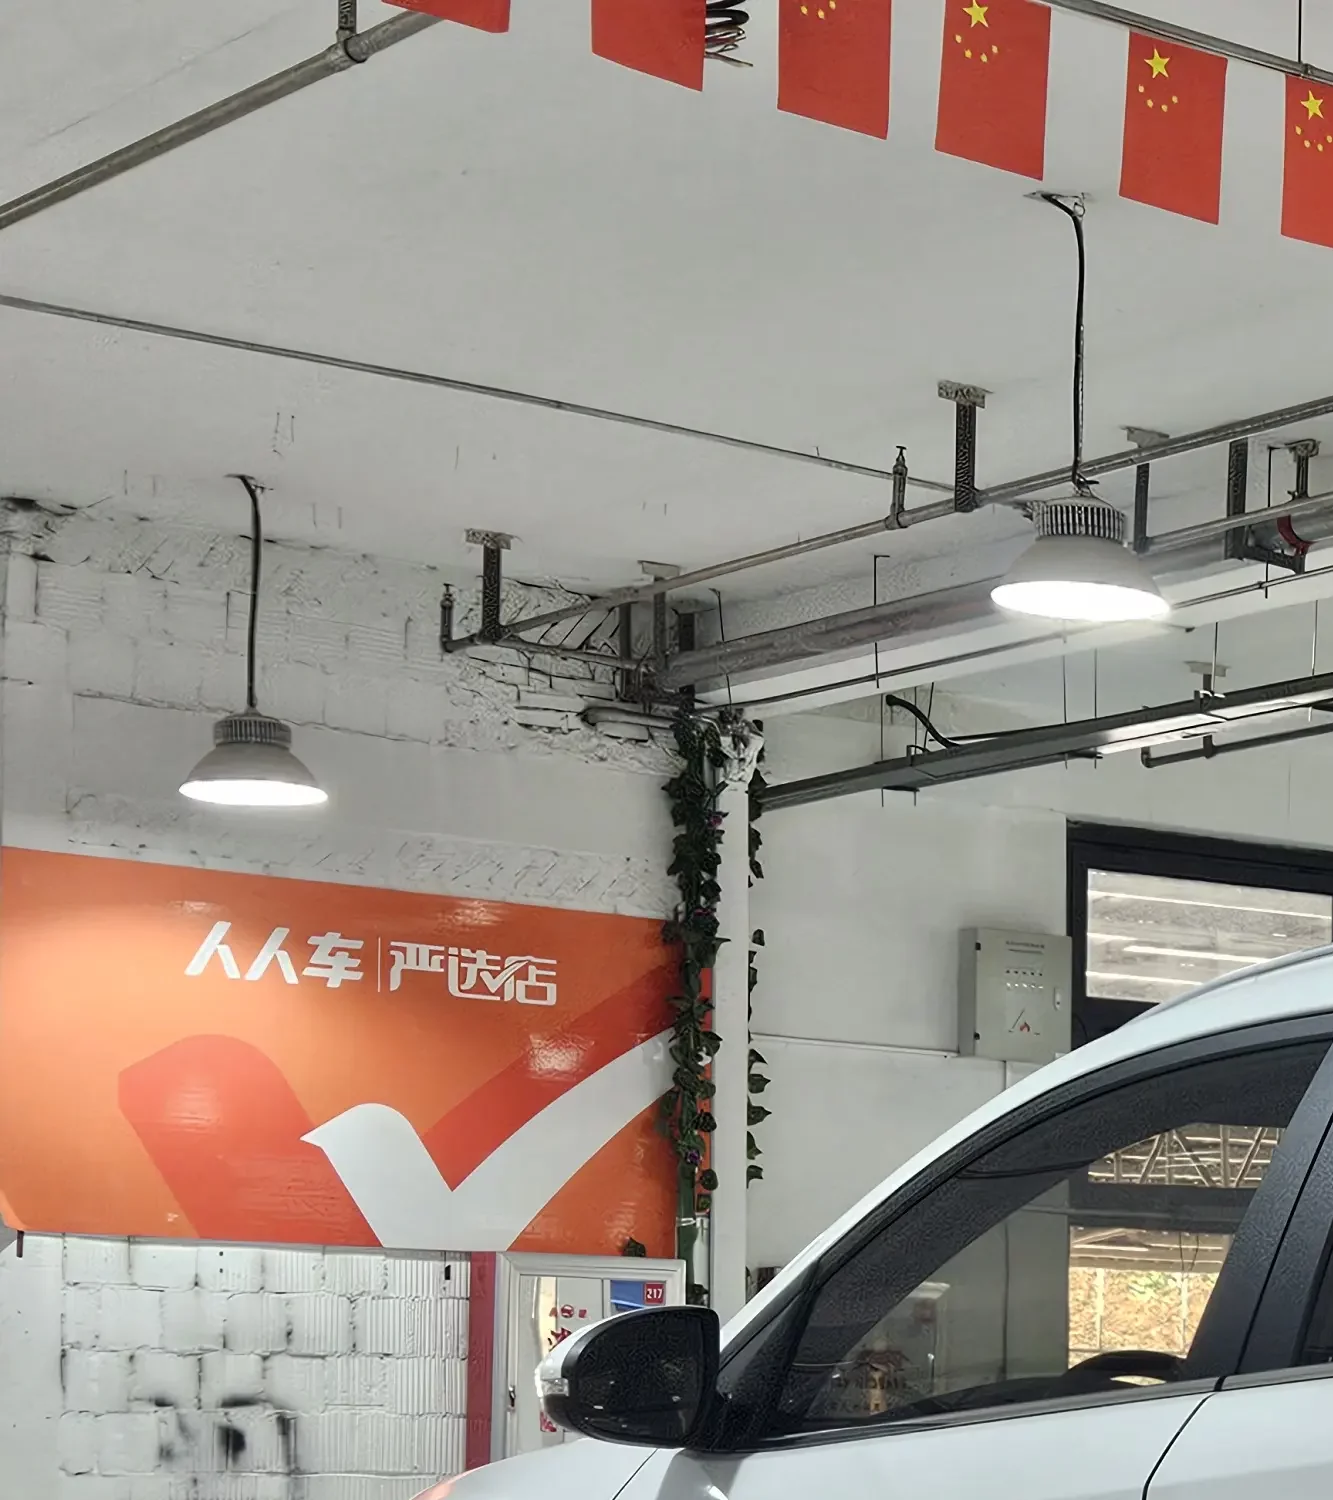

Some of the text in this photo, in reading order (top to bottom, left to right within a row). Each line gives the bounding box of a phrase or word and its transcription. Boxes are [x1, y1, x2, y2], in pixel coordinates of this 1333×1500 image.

[184, 920, 558, 1007] 人人车 严选店
[646, 1287, 663, 1300] 217
